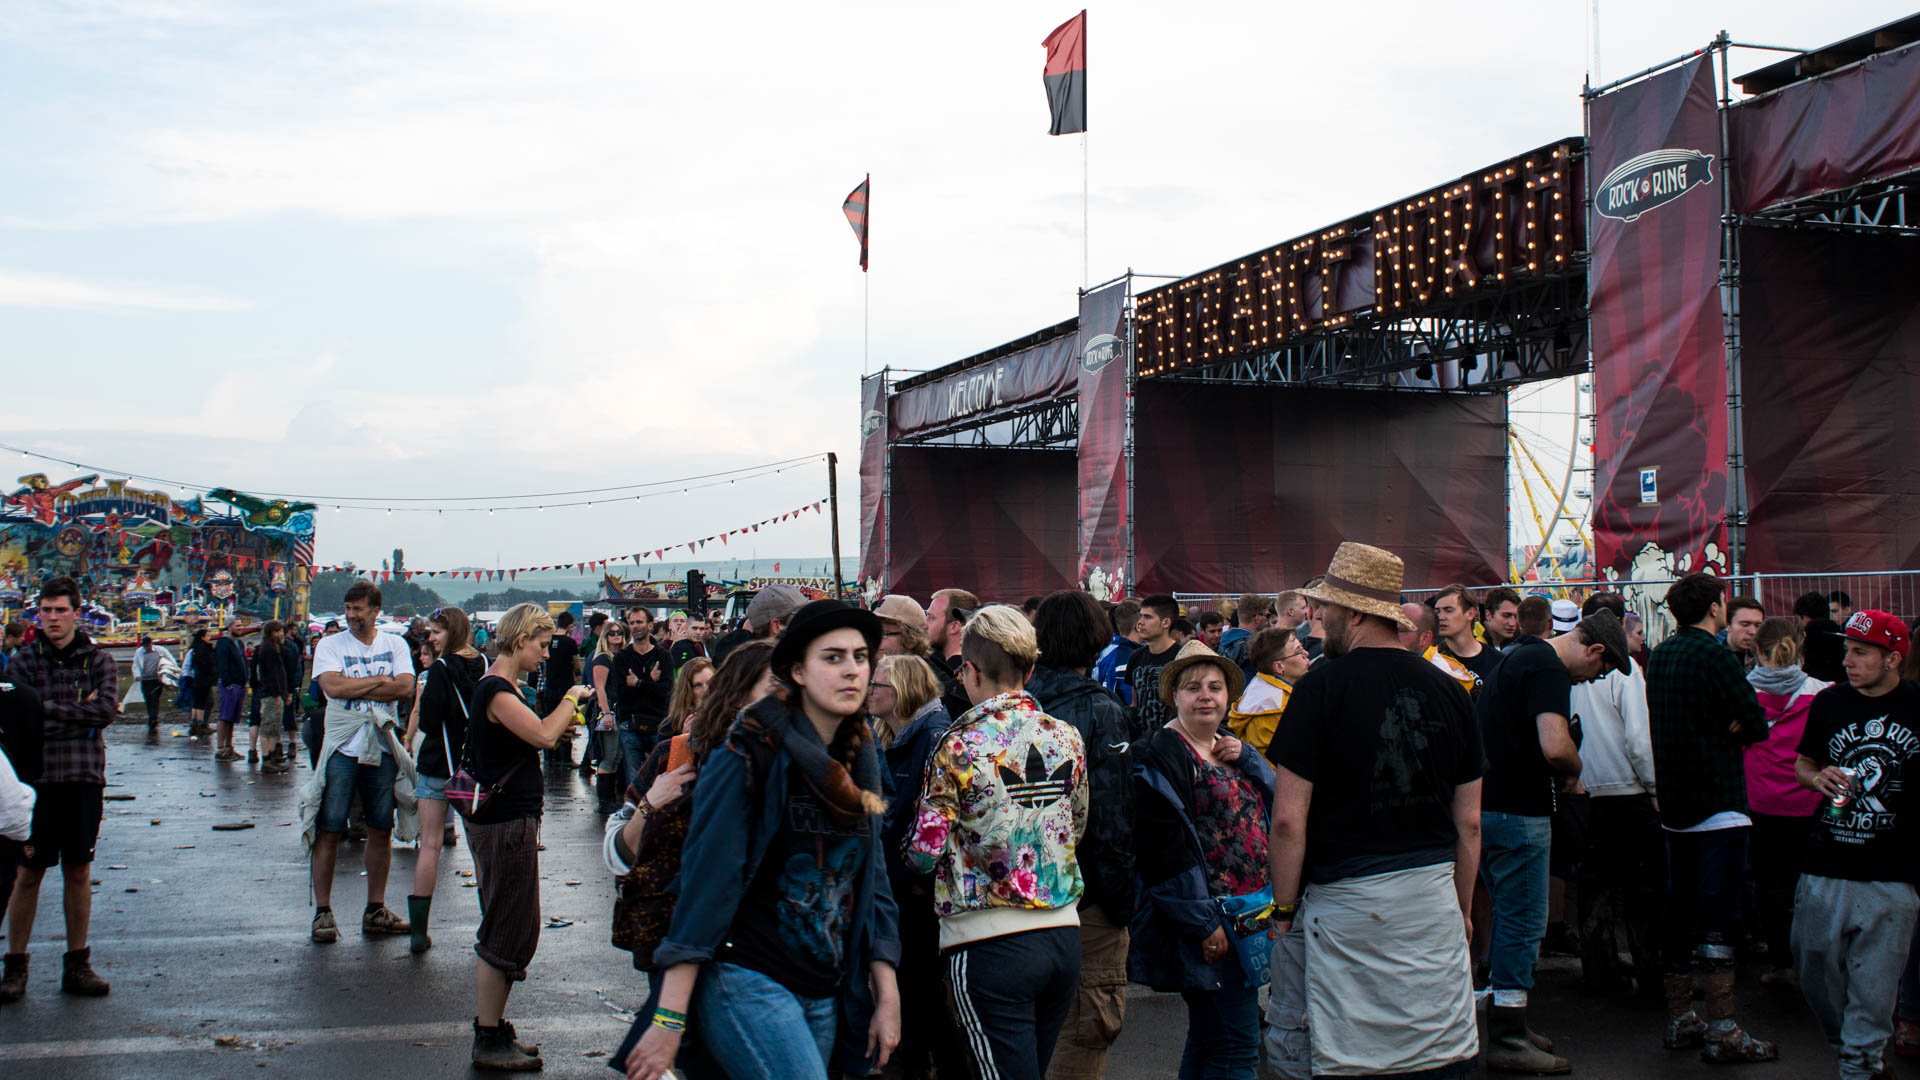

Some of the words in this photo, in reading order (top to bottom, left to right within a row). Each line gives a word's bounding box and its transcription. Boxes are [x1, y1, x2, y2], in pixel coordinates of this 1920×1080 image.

[1608, 177, 1640, 211] ROCK
[1652, 163, 1688, 197] RING
[1136, 223, 1353, 380] ENTRANCE
[1373, 144, 1572, 315] NORTH
[948, 367, 1004, 418] WELCOME
[56, 480, 169, 525] COMMANDER
[748, 576, 831, 592] SPEEDWAY
[1828, 722, 1862, 762] HOME
